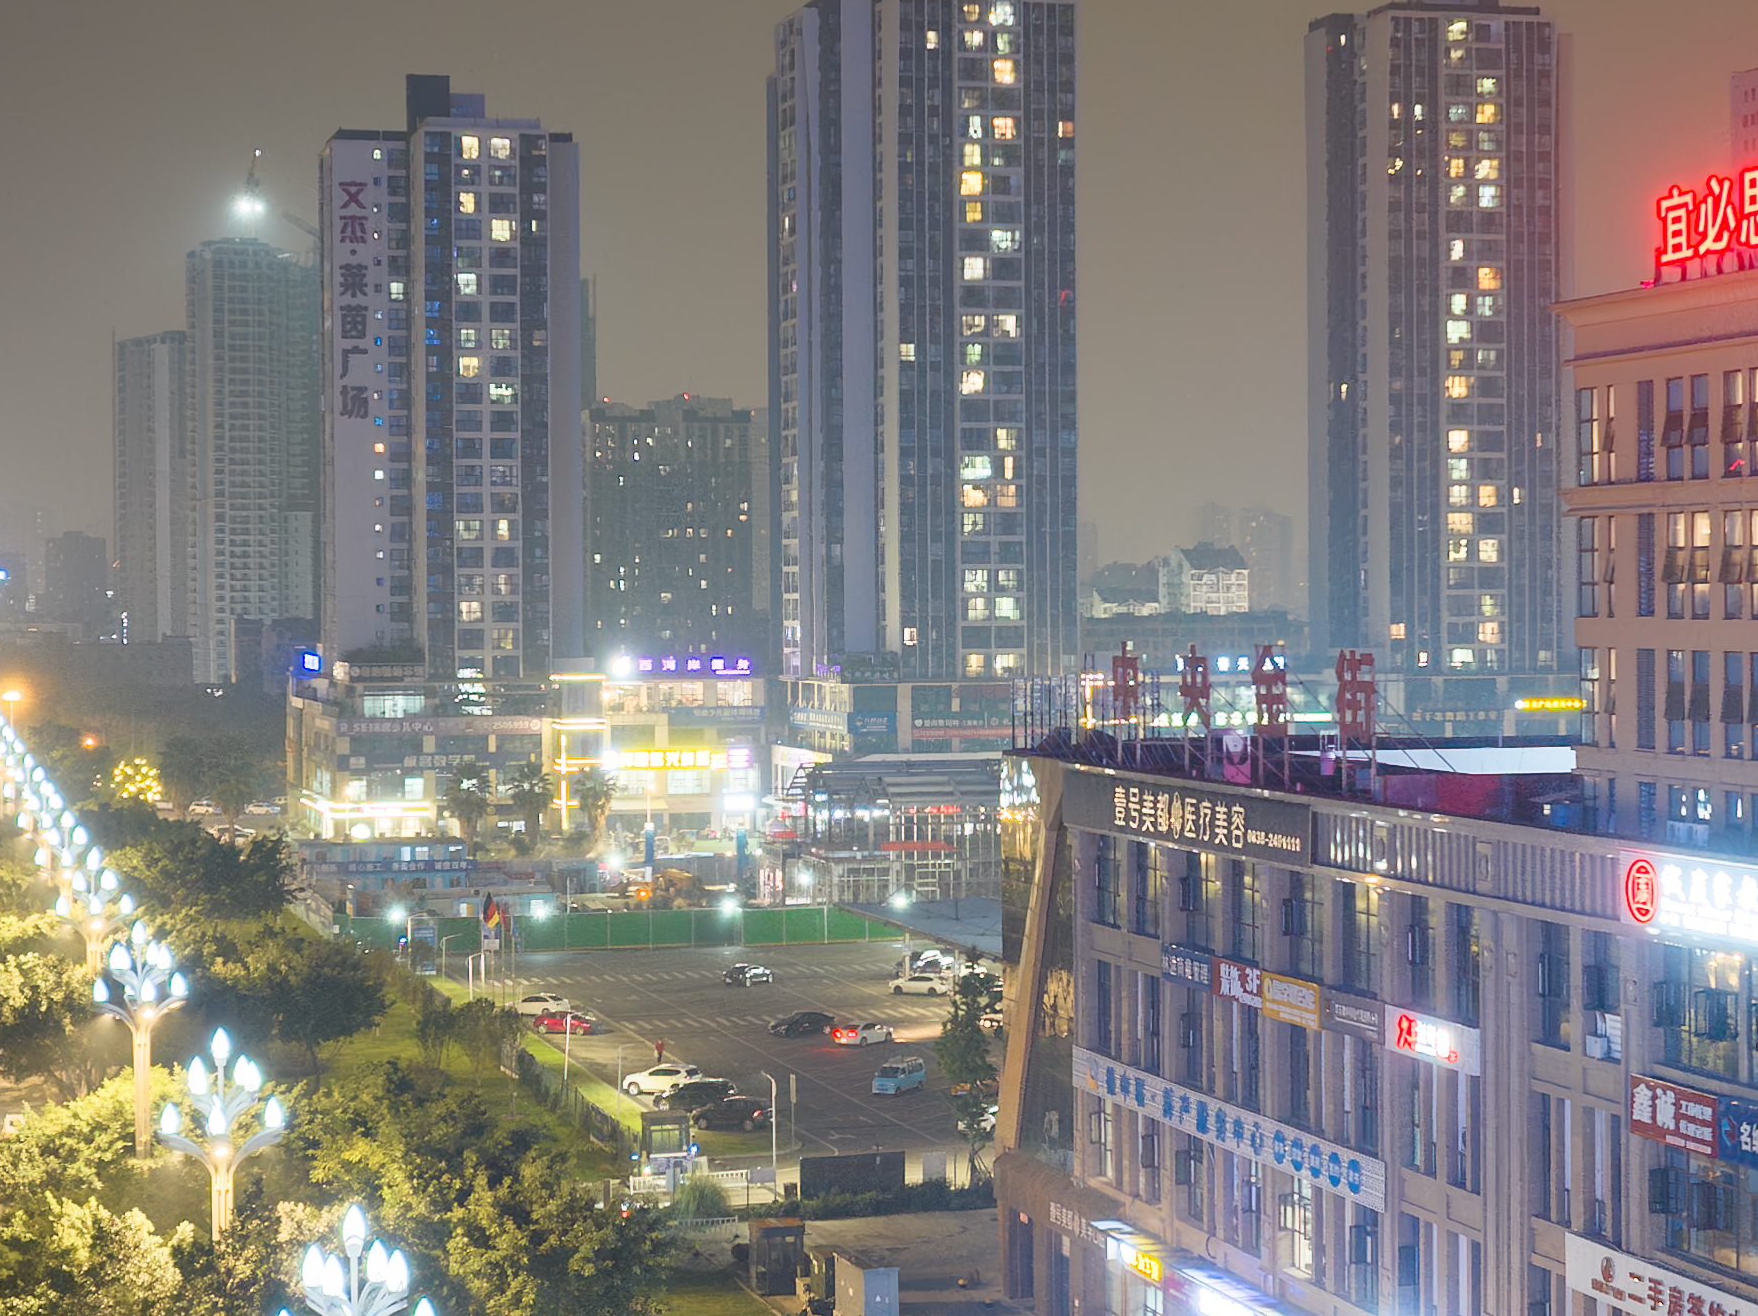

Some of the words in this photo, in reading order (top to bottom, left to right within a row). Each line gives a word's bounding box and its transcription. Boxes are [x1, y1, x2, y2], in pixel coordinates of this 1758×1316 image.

[338, 181, 370, 421] 文杰·莱茵广场
[1113, 784, 1170, 835] 壹号美都
[1183, 796, 1247, 849] 医疗美容
[1244, 966, 1262, 995] 3F
